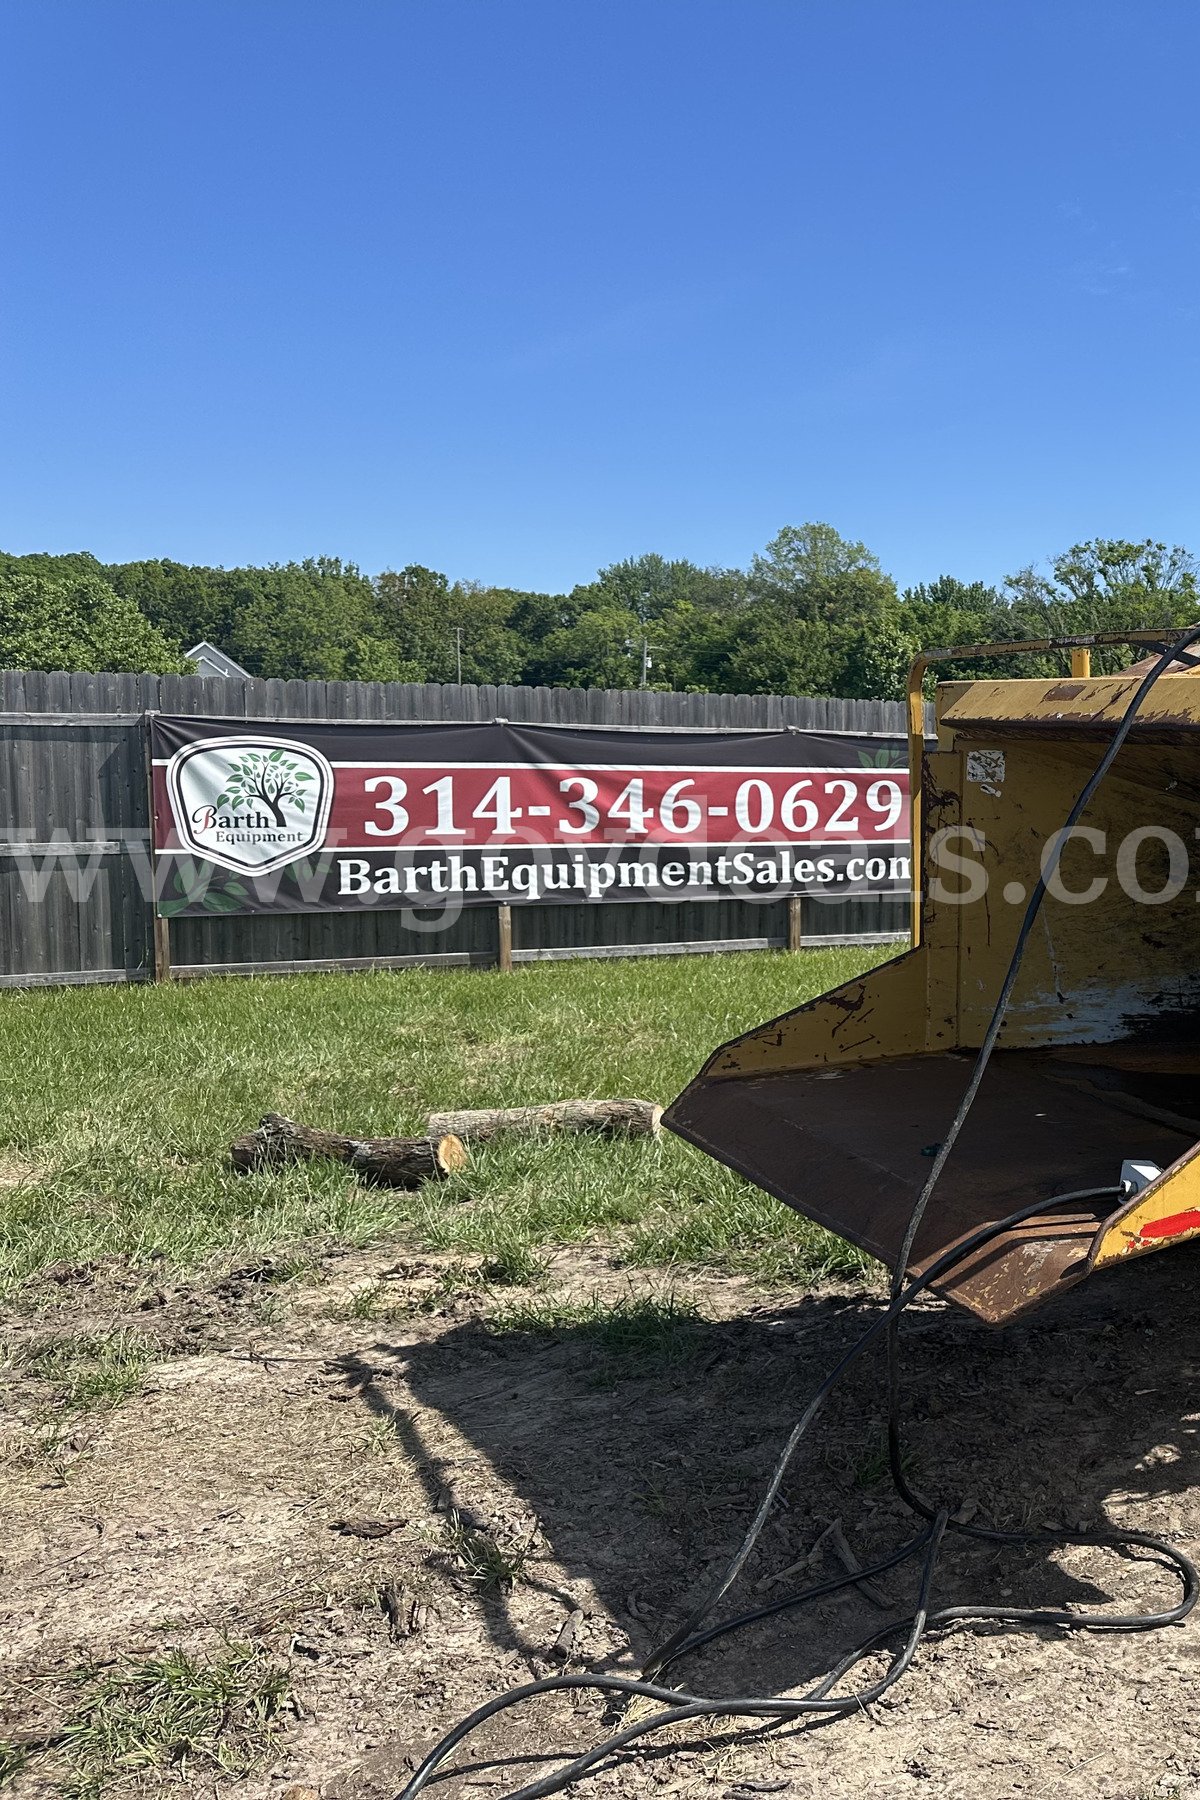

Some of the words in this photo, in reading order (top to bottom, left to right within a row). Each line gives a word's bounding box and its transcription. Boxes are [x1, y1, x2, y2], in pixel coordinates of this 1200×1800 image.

[192, 805, 270, 834] Barth
[364, 775, 903, 836] 314-346-0629
[215, 831, 304, 845] Equipment
